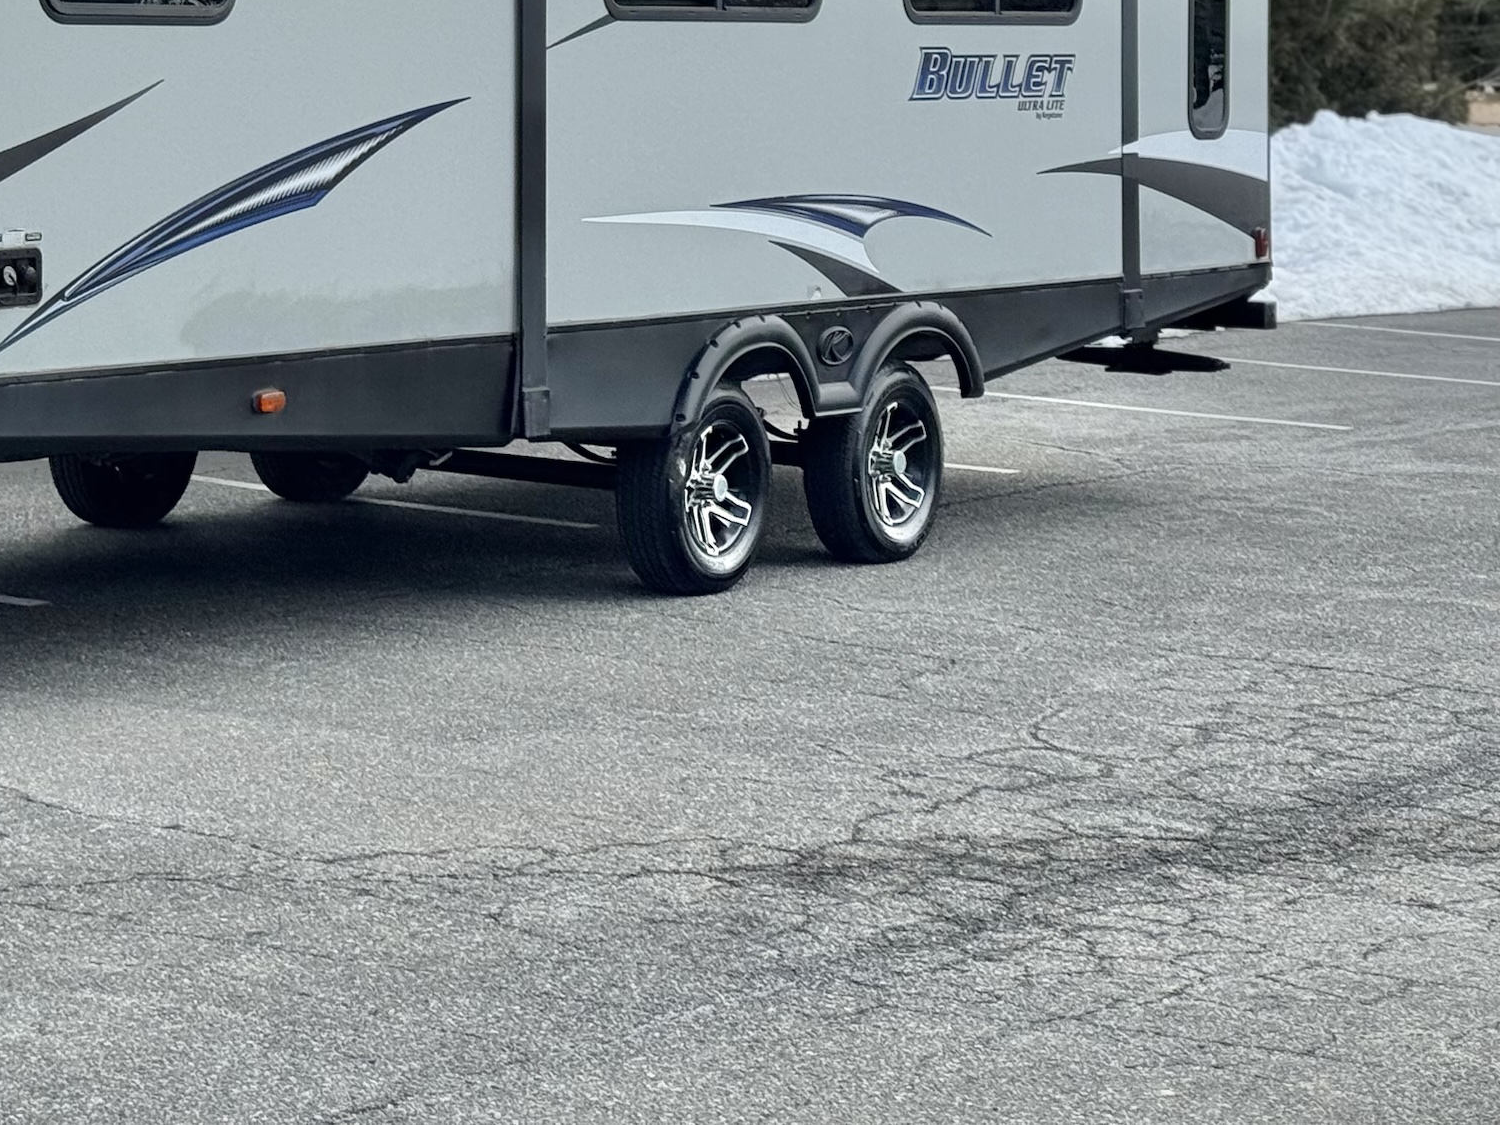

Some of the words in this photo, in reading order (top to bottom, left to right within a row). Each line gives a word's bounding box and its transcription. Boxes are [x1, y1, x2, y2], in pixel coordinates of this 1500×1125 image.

[908, 46, 1076, 101] BULLET
[1017, 100, 1044, 111] ULTRA
[1046, 99, 1065, 110] LITE
